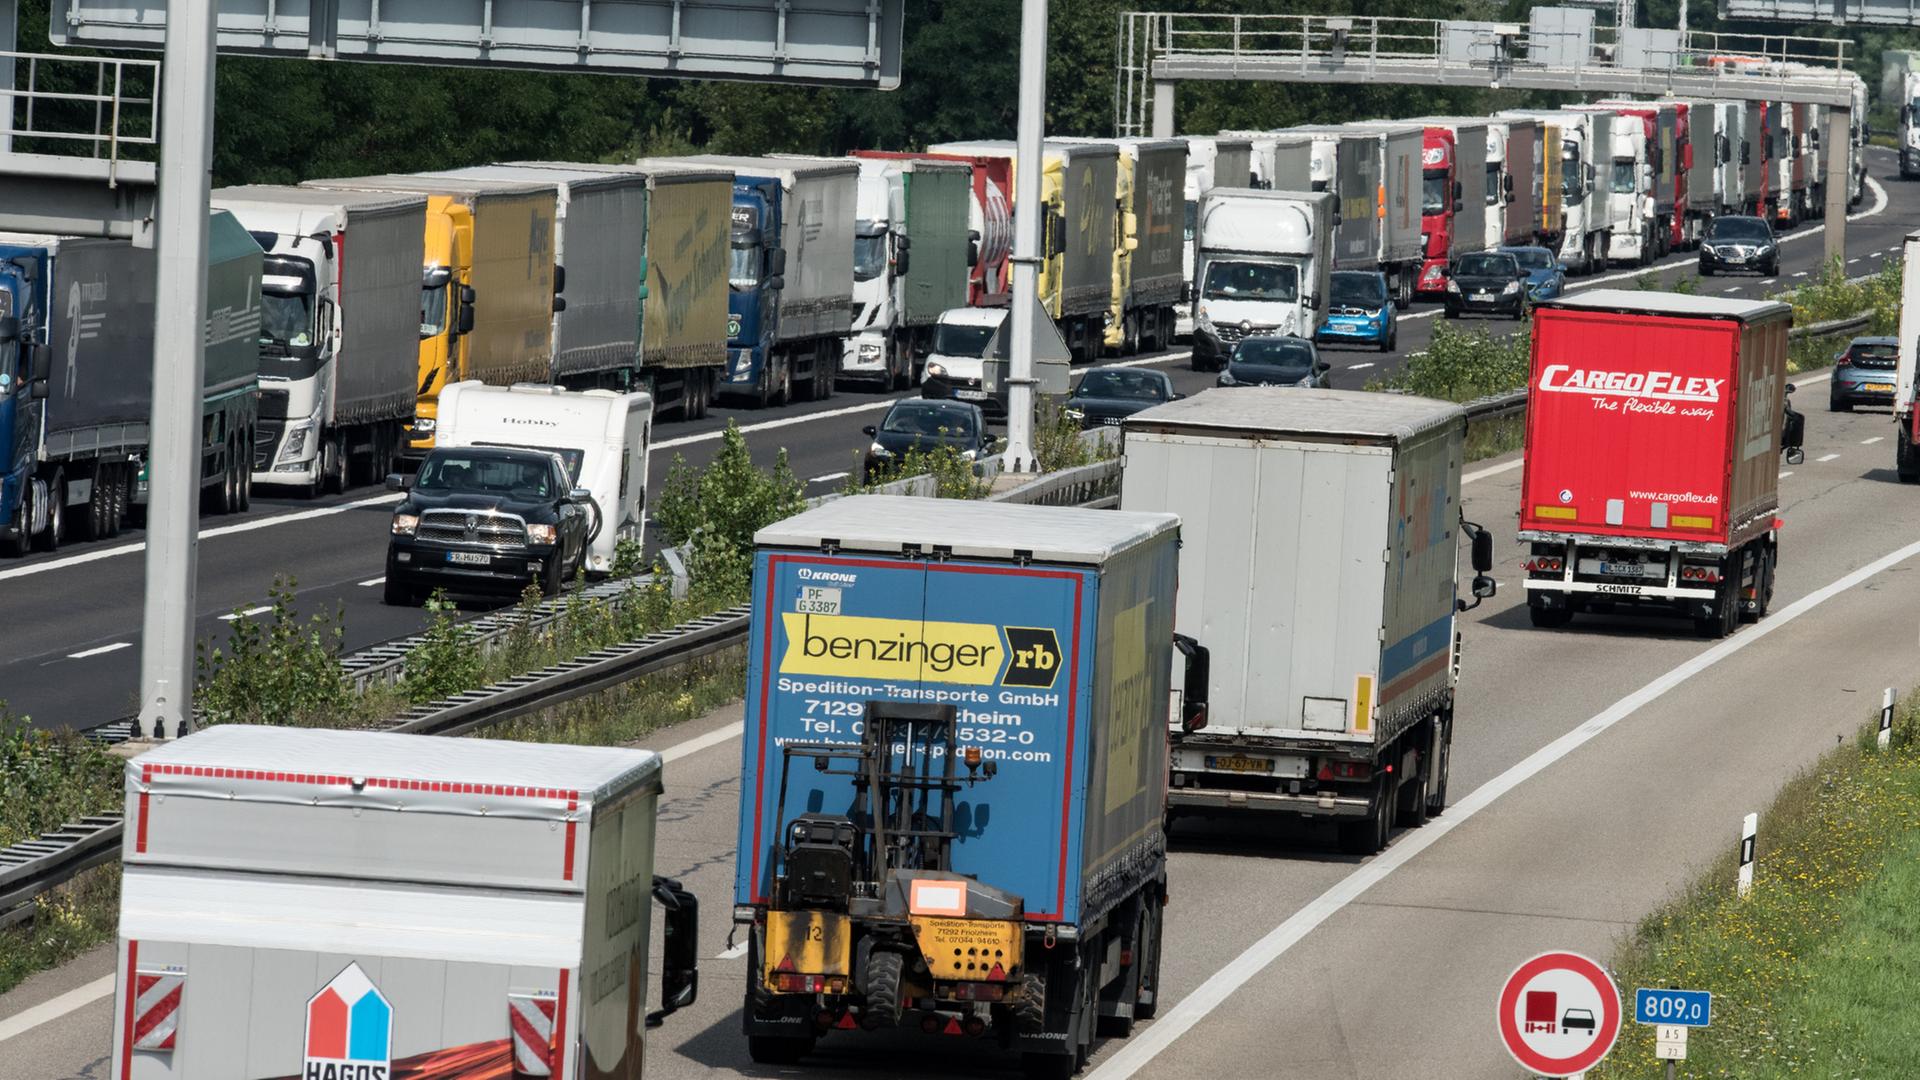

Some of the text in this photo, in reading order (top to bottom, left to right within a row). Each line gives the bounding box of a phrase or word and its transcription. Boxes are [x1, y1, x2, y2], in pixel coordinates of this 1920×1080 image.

[1591, 397, 1715, 421] The flexible way.
[503, 417, 558, 428] Hobby
[1630, 490, 1719, 504] www.cargoflex.de
[811, 572, 857, 583] KRONE
[808, 588, 823, 600] PF
[1596, 584, 1643, 595] SCHMITZ
[799, 600, 838, 613] G 3387
[803, 613, 995, 672] benzinger
[1016, 644, 1055, 671] rb
[778, 677, 1059, 707] Spedition-Transporte GmbH
[805, 699, 866, 717] 7129
[800, 718, 841, 734] Tel.
[806, 926, 823, 942] 12
[1645, 996, 1701, 1020] 809,0
[1665, 1029, 1679, 1040] A 5
